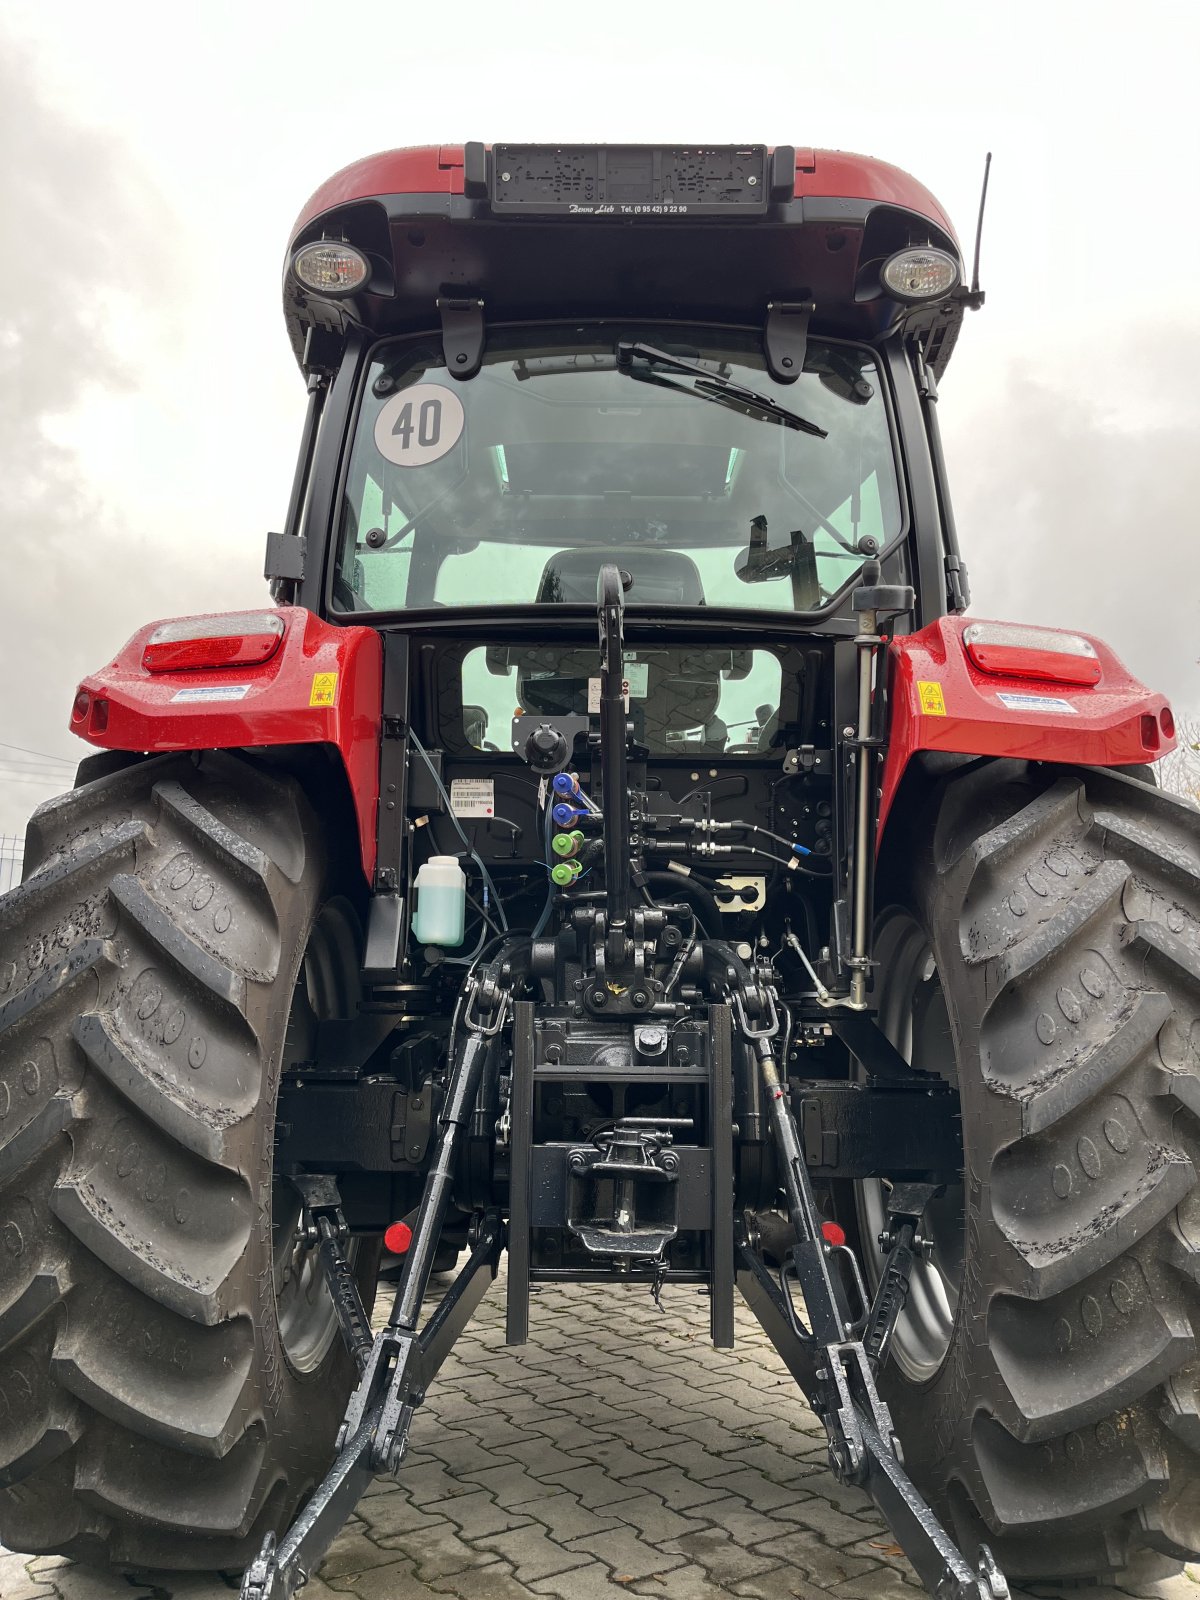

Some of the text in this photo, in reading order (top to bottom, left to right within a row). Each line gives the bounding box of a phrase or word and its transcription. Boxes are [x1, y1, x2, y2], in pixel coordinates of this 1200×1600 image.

[621, 205, 633, 213] Tel.
[642, 205, 651, 213] 95
[663, 205, 669, 213] 9
[669, 205, 678, 213] 22
[679, 205, 687, 213] 90
[391, 399, 442, 450] 40
